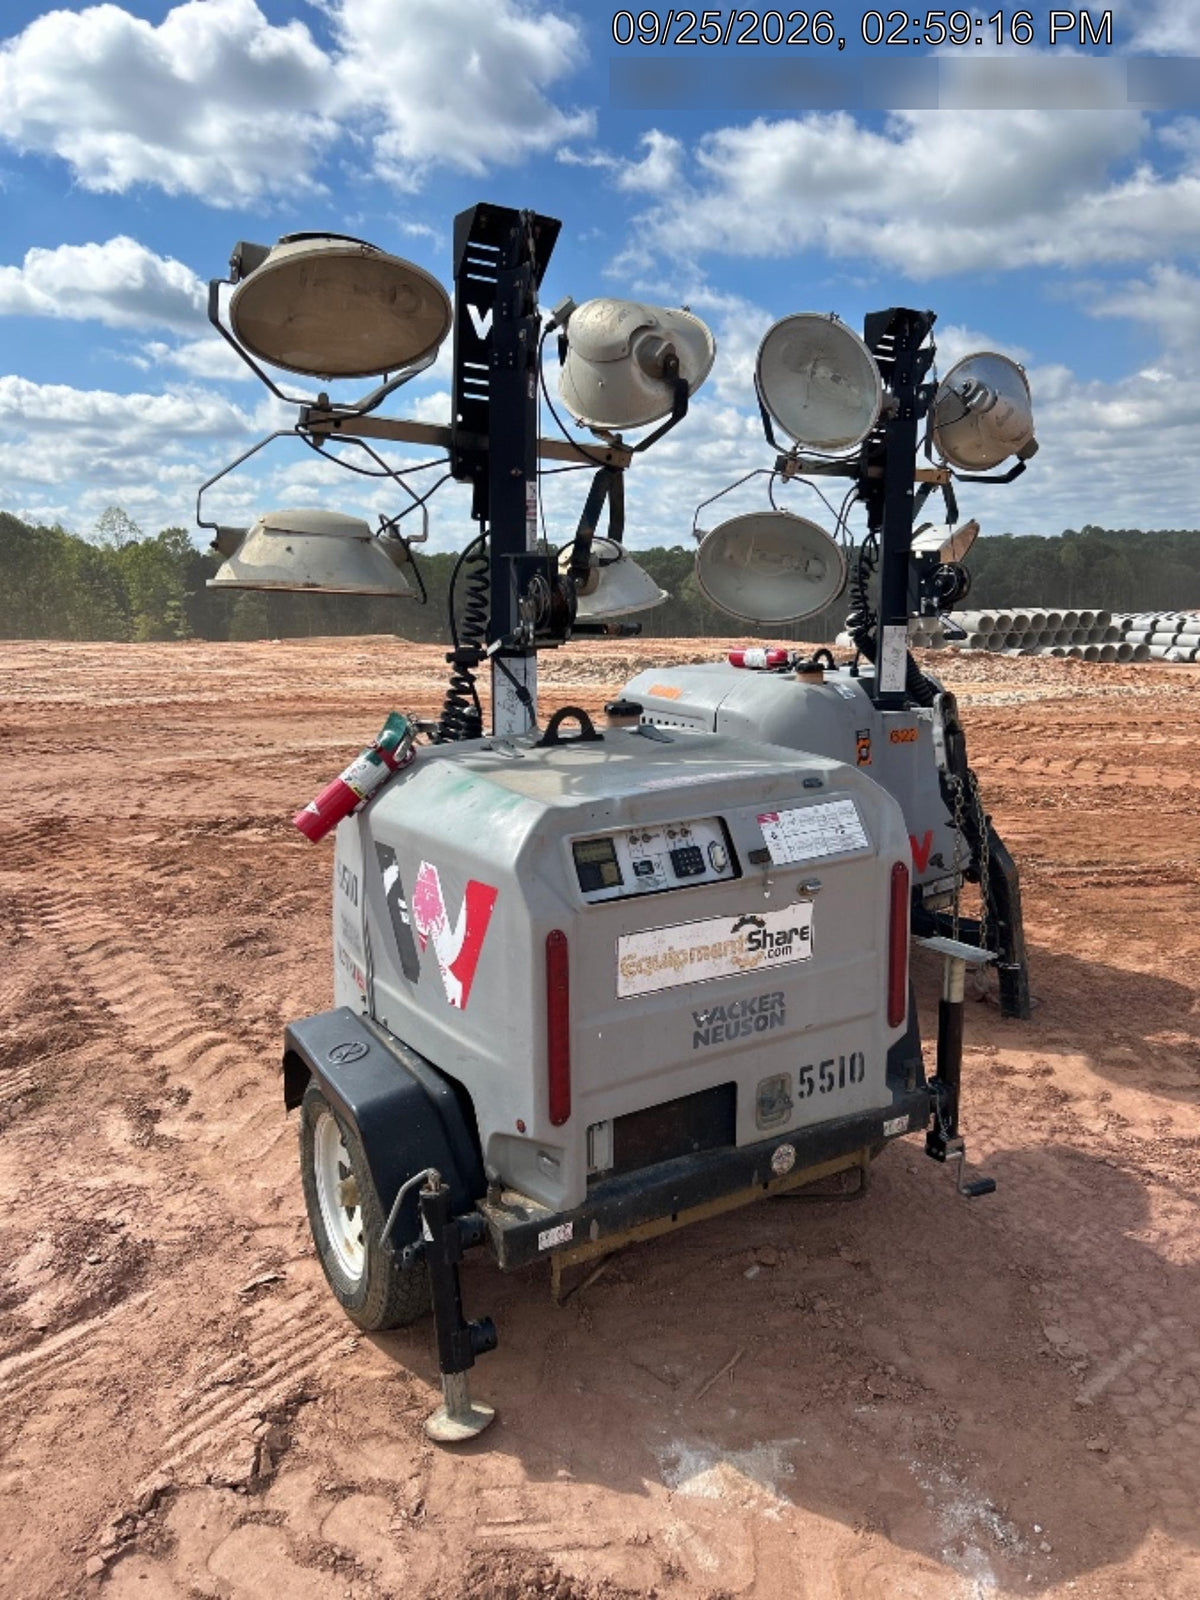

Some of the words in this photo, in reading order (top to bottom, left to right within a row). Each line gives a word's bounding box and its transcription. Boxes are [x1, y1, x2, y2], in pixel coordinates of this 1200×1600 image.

[692, 991, 786, 1028] WACKER
[693, 1010, 786, 1049] NEUSON
[798, 1052, 865, 1098] 5510
